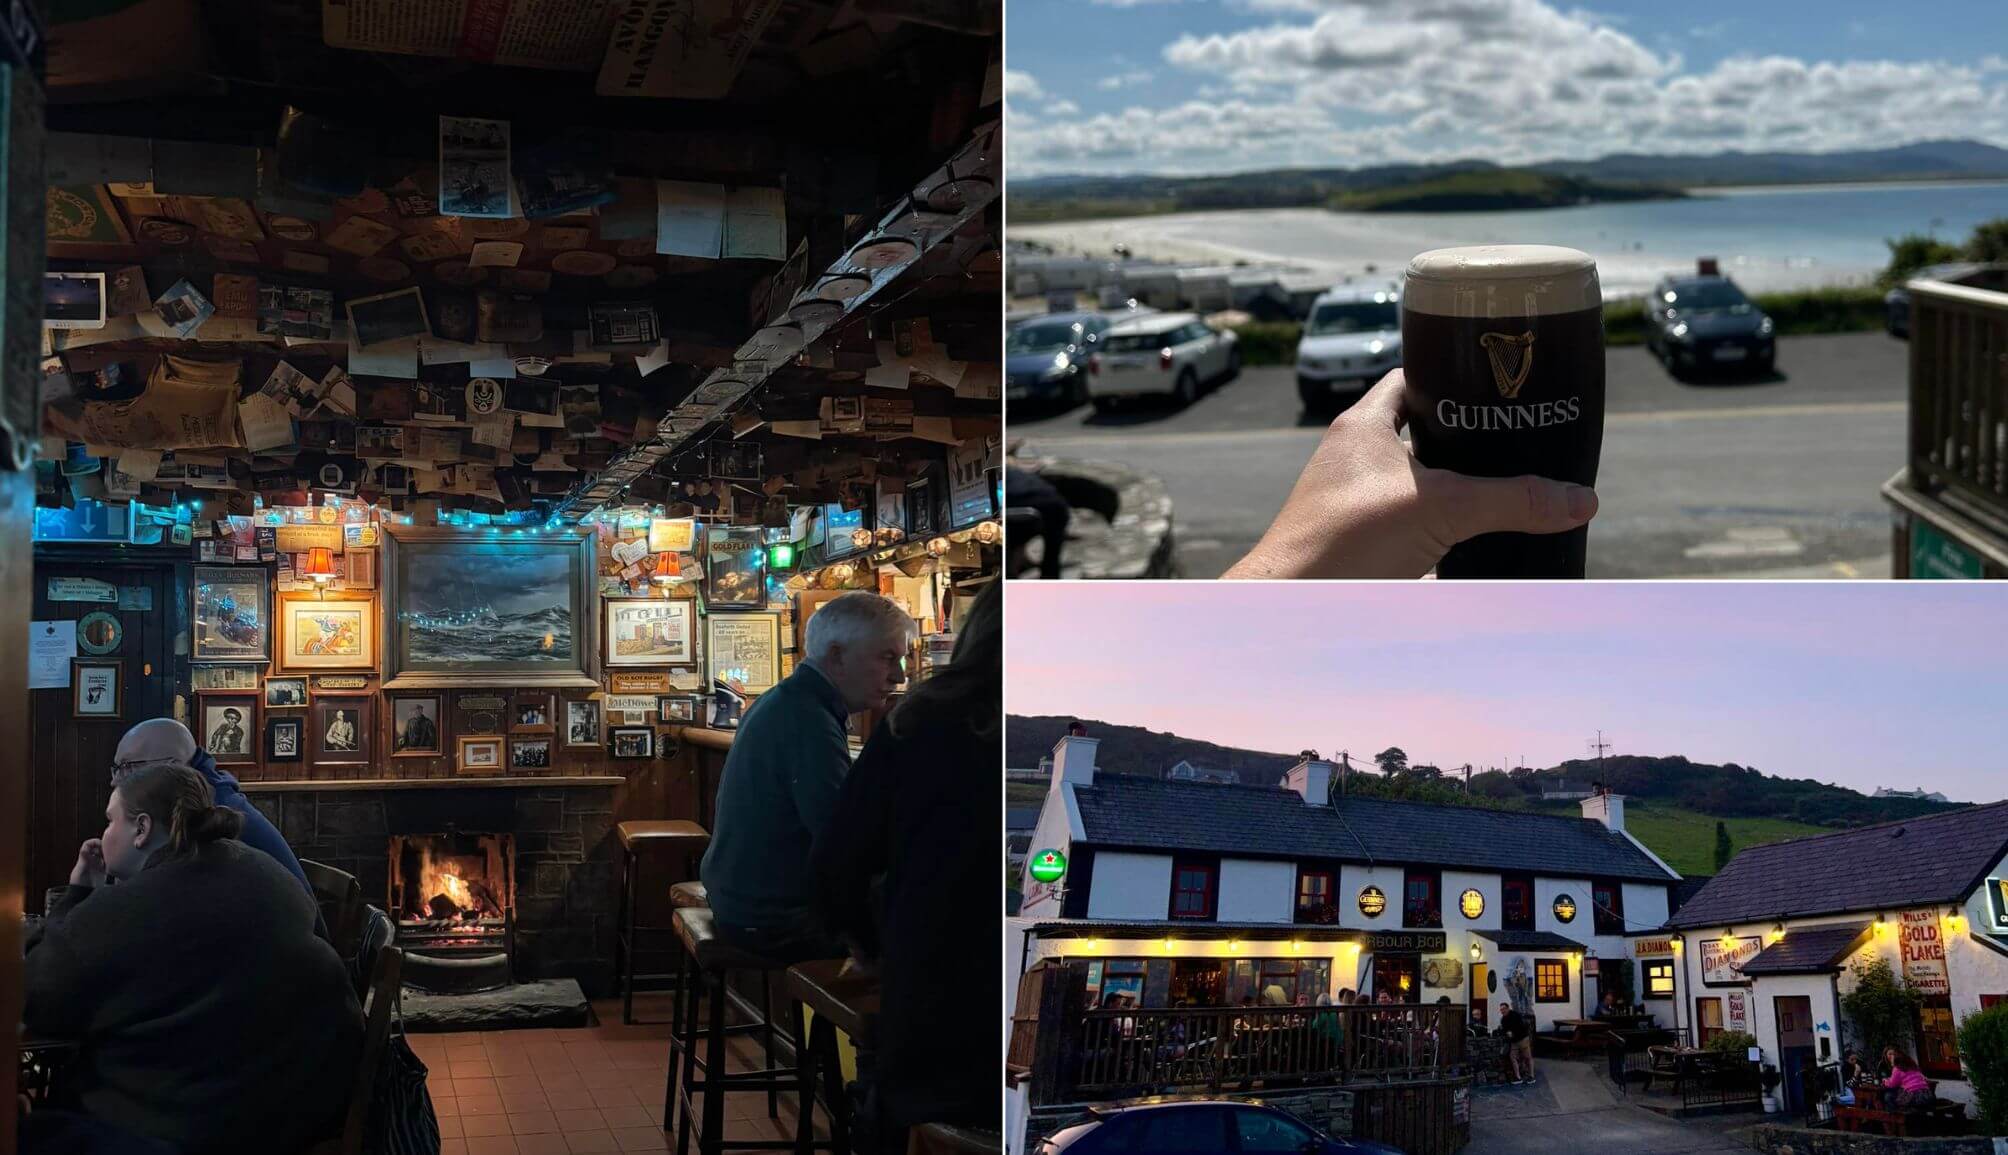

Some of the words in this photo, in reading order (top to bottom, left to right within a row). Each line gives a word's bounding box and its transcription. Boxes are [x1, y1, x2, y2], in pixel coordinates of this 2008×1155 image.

[1436, 396, 1581, 431] GUINNESS
[1902, 926, 1937, 943] GOLD
[1647, 939, 1673, 953] DIAMON
[1903, 944, 1942, 961] FLAKE
[1705, 940, 1759, 970] DIAMONDS
